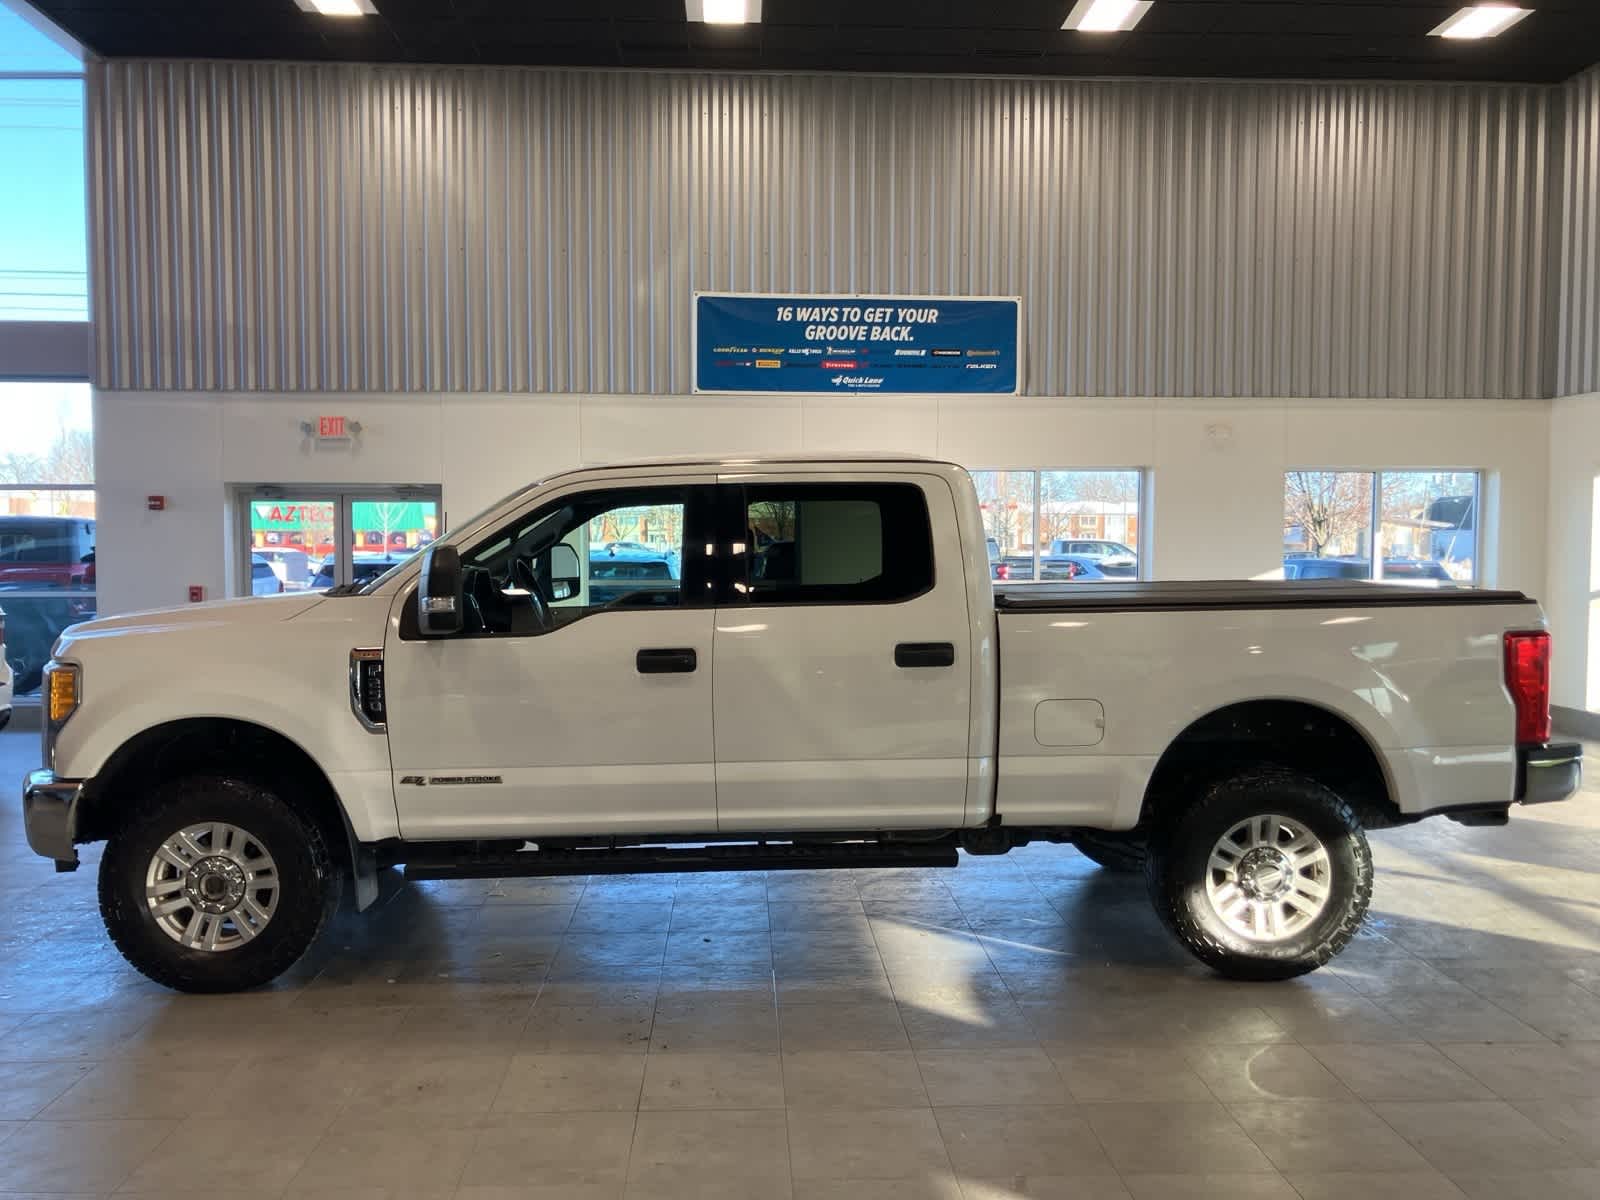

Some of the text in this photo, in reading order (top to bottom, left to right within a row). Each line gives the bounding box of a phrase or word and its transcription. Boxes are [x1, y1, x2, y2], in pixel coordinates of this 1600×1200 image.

[777, 307, 939, 323] 16 WAYS TO GET YOUR
[805, 325, 914, 341] GROOVE BACK.
[842, 376, 864, 384] Quick
[320, 416, 345, 436] EXIT
